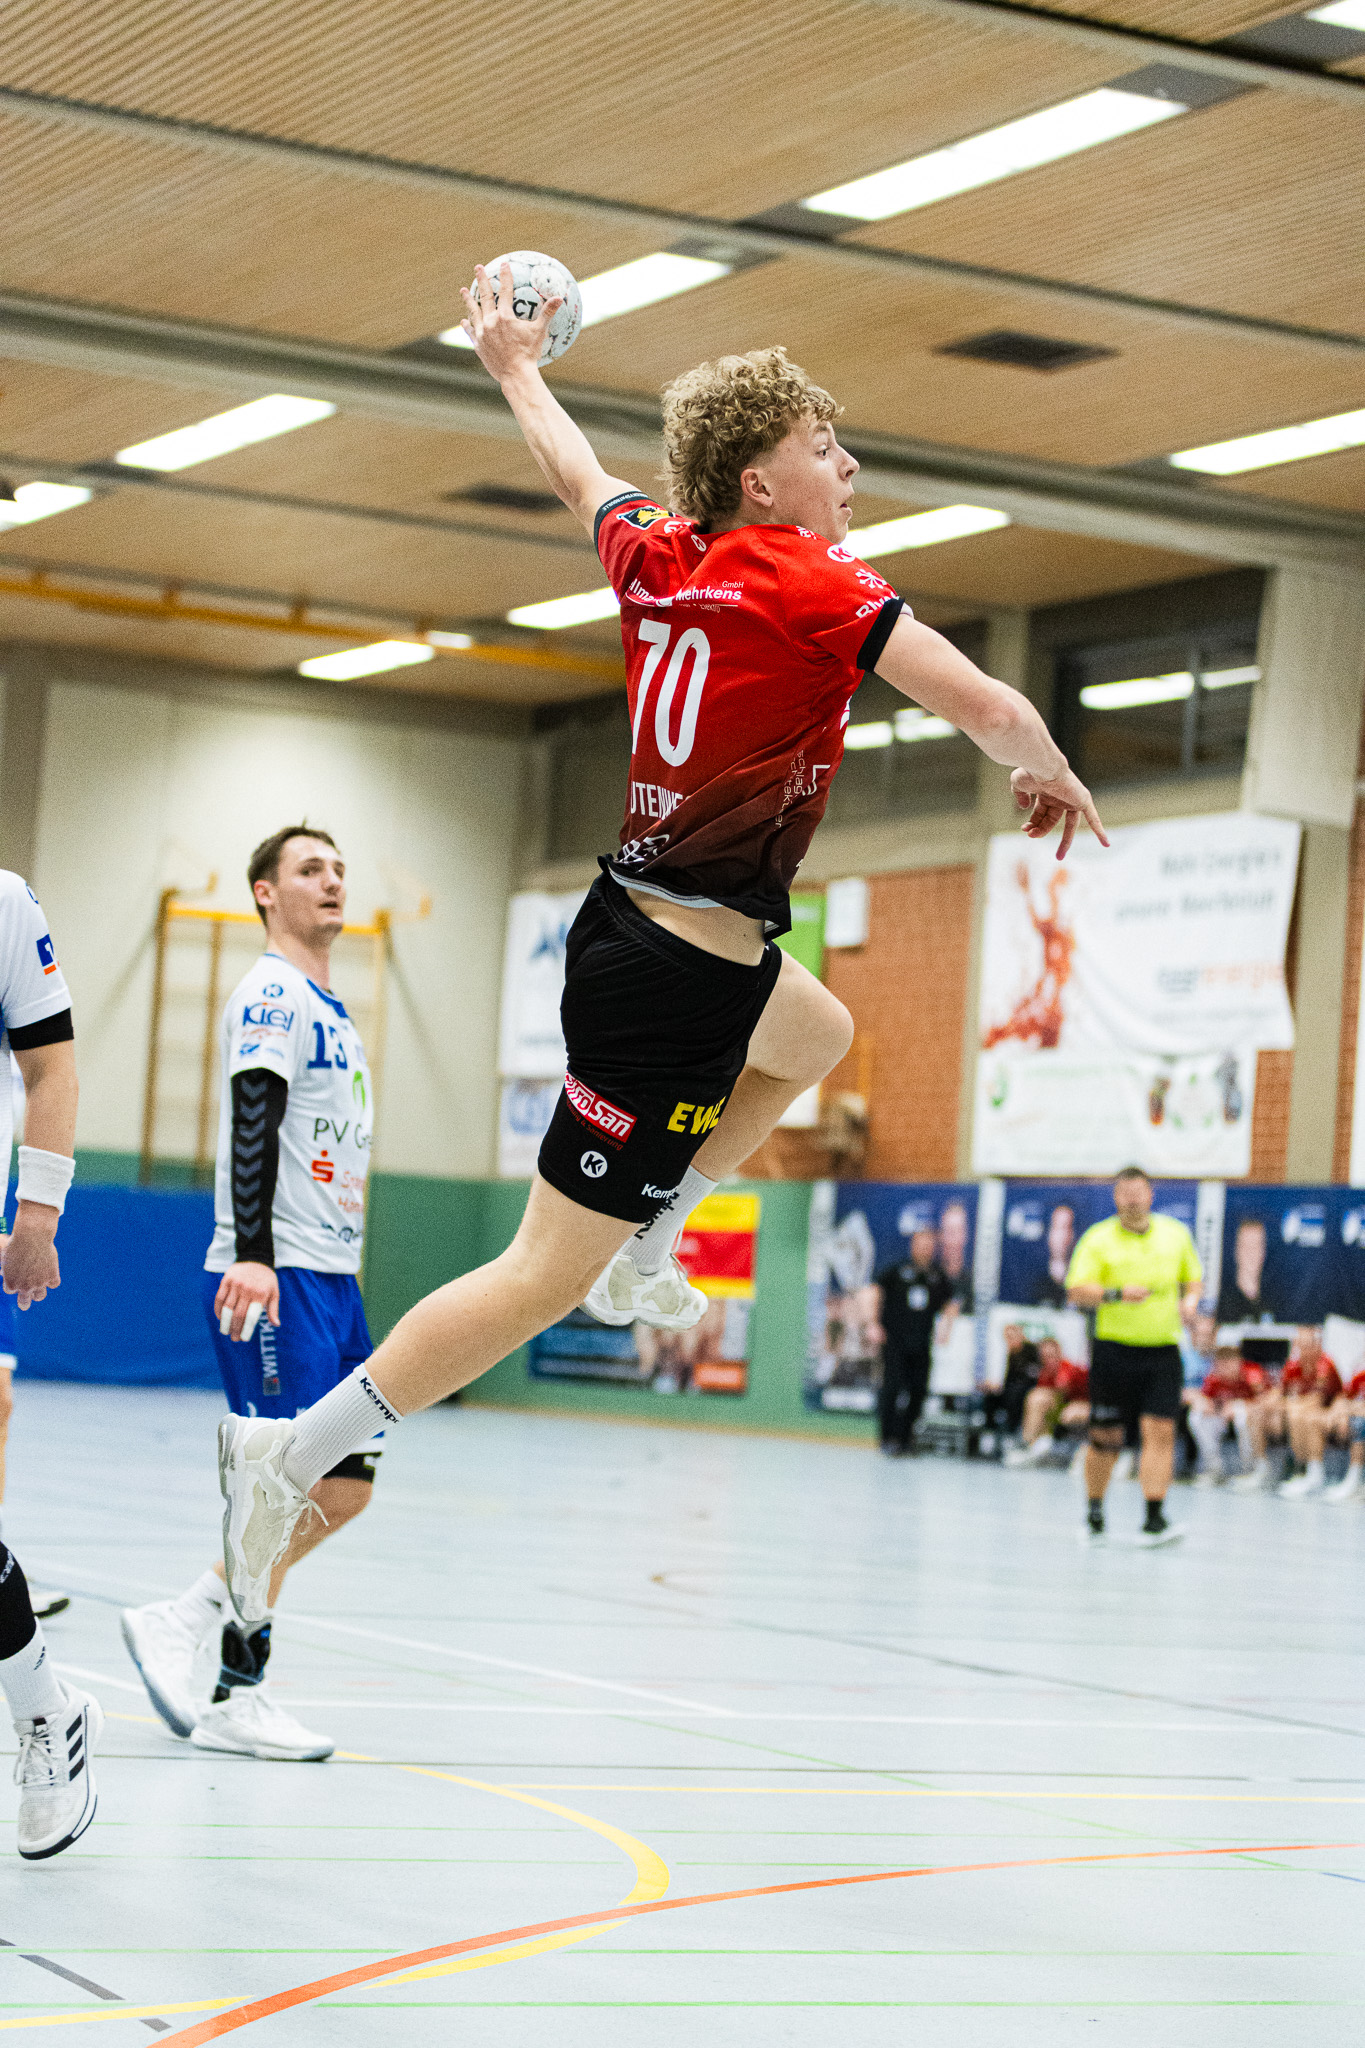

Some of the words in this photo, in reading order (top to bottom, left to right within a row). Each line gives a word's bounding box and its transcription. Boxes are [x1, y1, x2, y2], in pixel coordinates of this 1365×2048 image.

[722, 580, 744, 589] GmbH
[632, 617, 711, 767] 70
[242, 1003, 295, 1032] Kiel
[307, 1021, 348, 1070] 13
[313, 1117, 349, 1144] PV
[259, 1306, 279, 1378] WITTK
